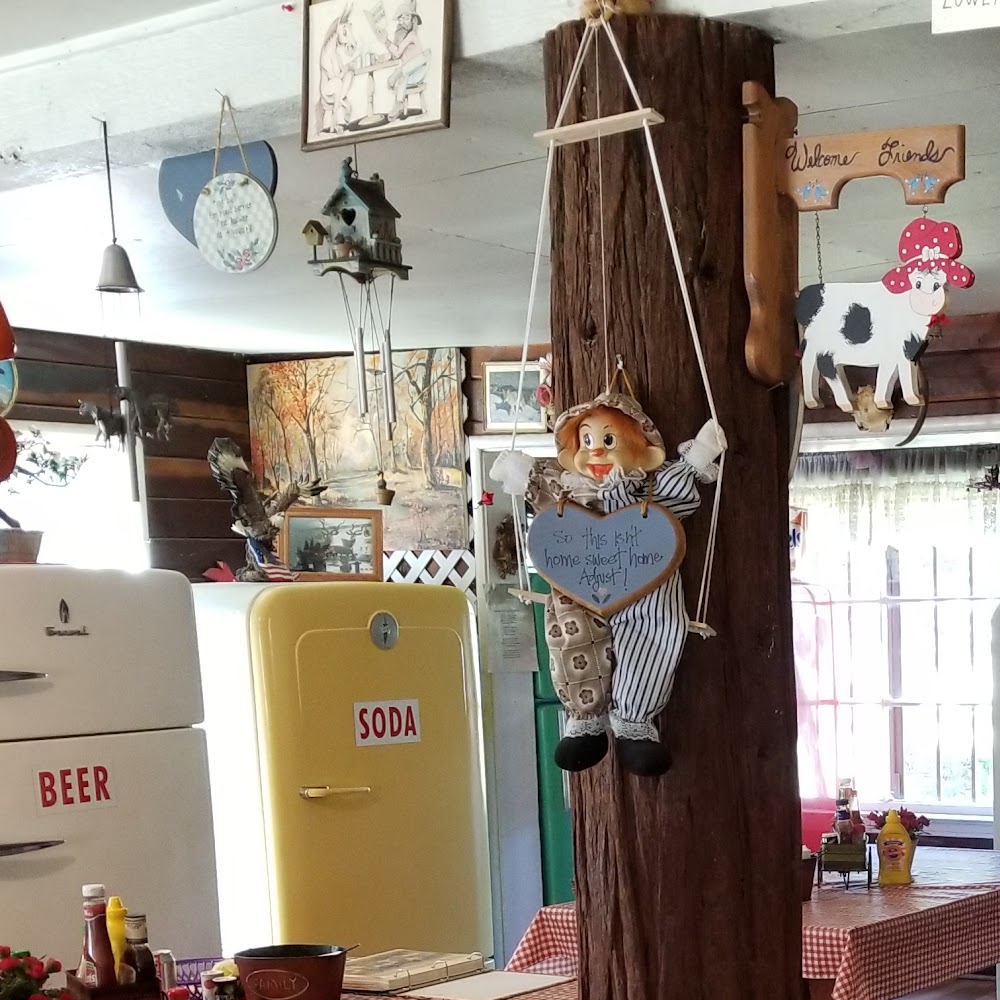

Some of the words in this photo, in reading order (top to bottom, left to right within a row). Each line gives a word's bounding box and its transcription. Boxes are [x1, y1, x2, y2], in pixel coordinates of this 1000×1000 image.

[785, 141, 861, 172] Welcome
[878, 136, 955, 167] Friends
[552, 530, 573, 544] So
[582, 527, 608, 550] this
[544, 548, 581, 568] home
[585, 548, 627, 570] sweet
[628, 547, 664, 568] home
[358, 705, 417, 740] SODA
[38, 765, 111, 808] BEER
